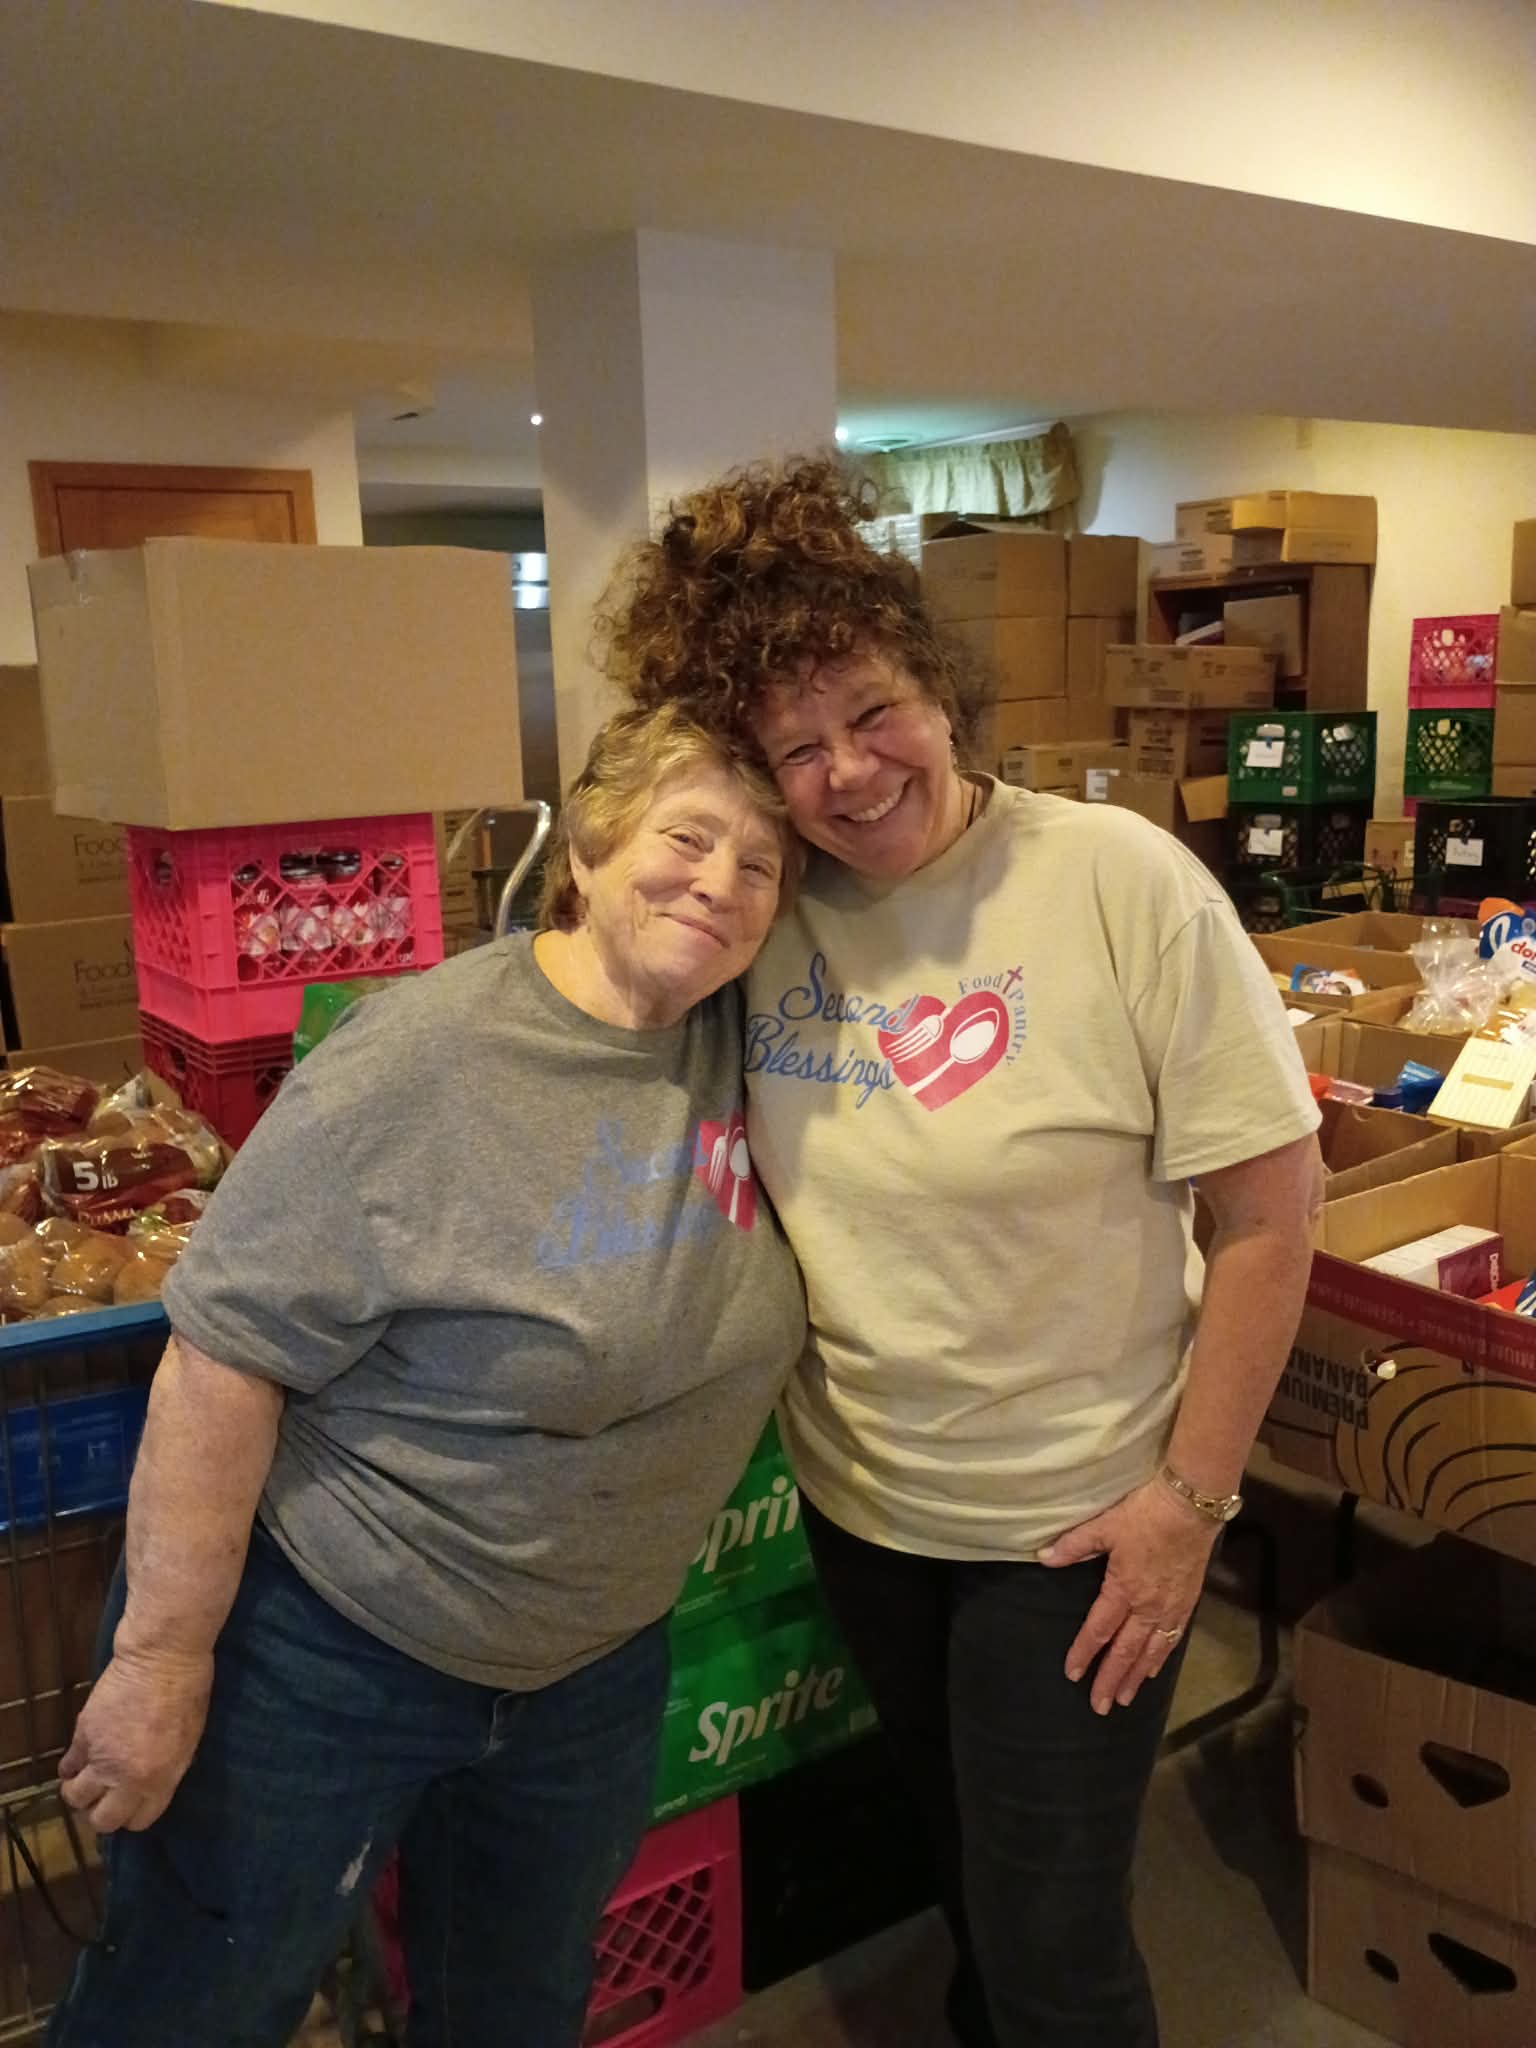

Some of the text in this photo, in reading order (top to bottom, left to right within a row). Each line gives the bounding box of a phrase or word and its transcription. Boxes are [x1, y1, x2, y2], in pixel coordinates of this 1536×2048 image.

[778, 951, 920, 1034] Second
[958, 973, 1004, 996] Food
[744, 1013, 896, 1111] Blessings
[689, 1664, 845, 1767] Sprite
